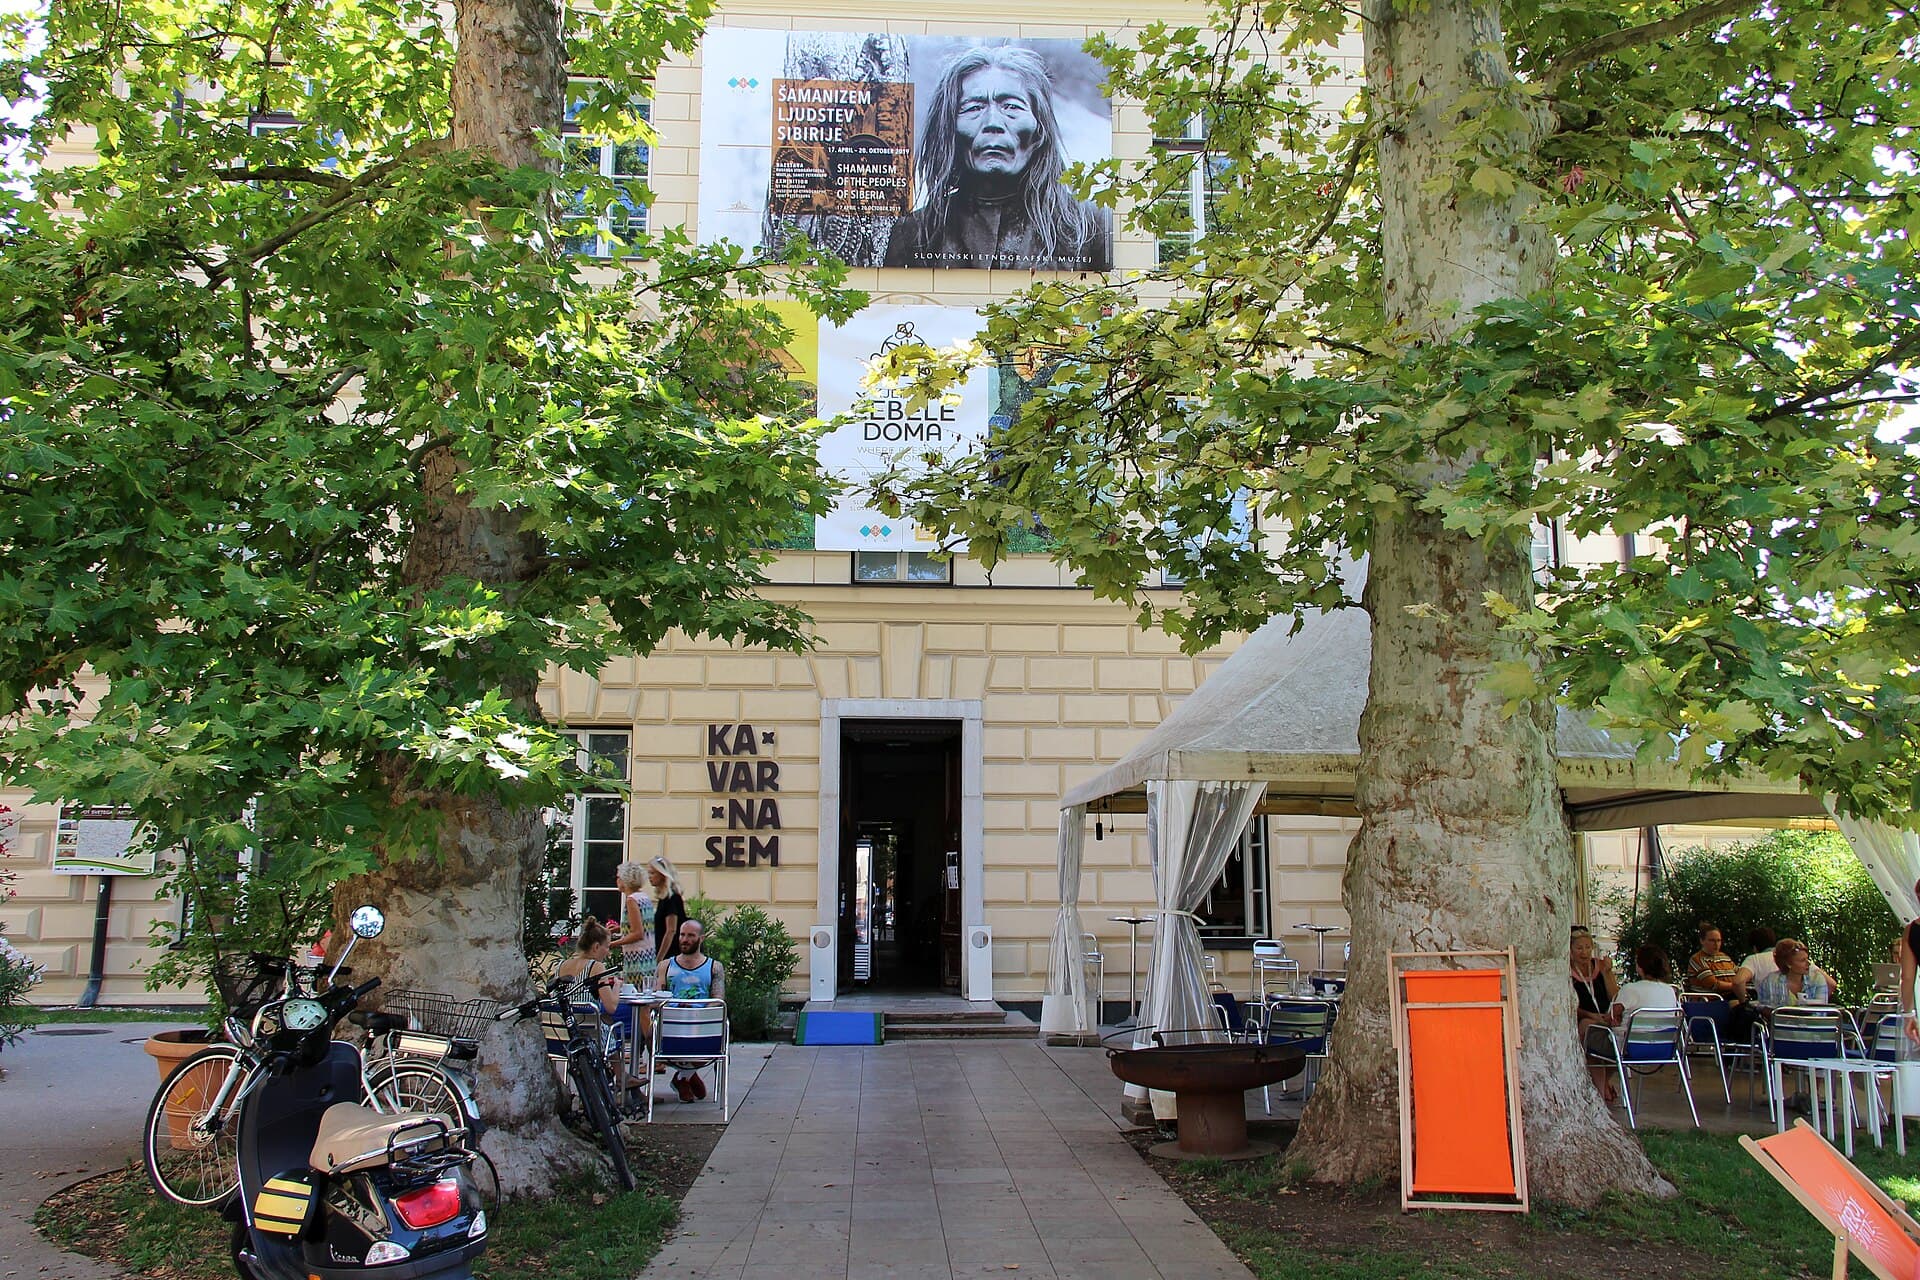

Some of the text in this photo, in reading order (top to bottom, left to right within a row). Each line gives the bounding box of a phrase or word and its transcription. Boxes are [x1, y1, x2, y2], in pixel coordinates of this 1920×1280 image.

[778, 84, 871, 105] ŠAMANIZEM
[778, 107, 854, 123] LJUDSTEV
[777, 126, 842, 142] SIBIRIJE
[837, 164, 897, 174] SHAMANISM
[837, 176, 907, 188] OF THE PEOPLES
[837, 189, 886, 200] OF SIBERIA
[914, 252, 974, 260] SLOVENSKI
[978, 253, 1053, 262] ETNOGRAFSKI
[851, 393, 956, 421] EBLE
[864, 422, 942, 441] DOMA
[708, 724, 758, 756] KA
[706, 760, 780, 793] VAR
[728, 798, 781, 830] NA
[705, 835, 779, 868] SEM
[330, 1243, 360, 1263] Vespa
